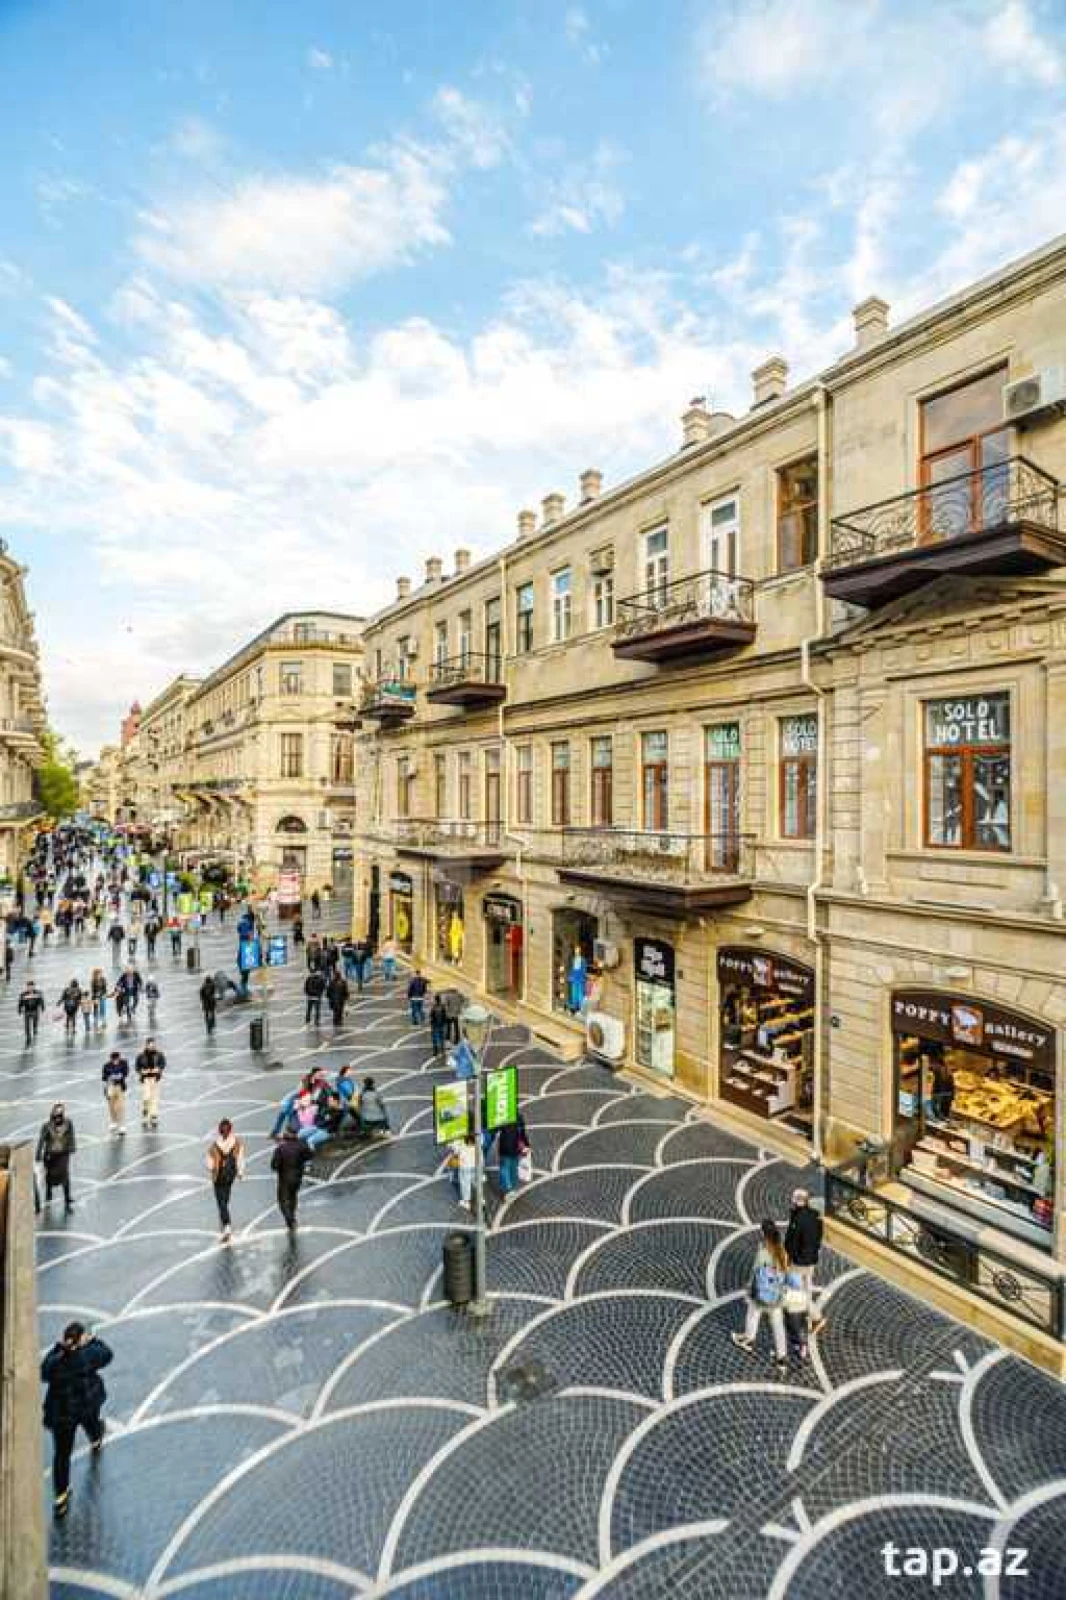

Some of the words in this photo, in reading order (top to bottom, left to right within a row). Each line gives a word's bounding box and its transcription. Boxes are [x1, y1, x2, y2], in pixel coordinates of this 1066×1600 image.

[944, 702, 989, 721] SOLO
[935, 719, 1000, 742] HOTEL
[894, 1001, 950, 1026] POPPY
